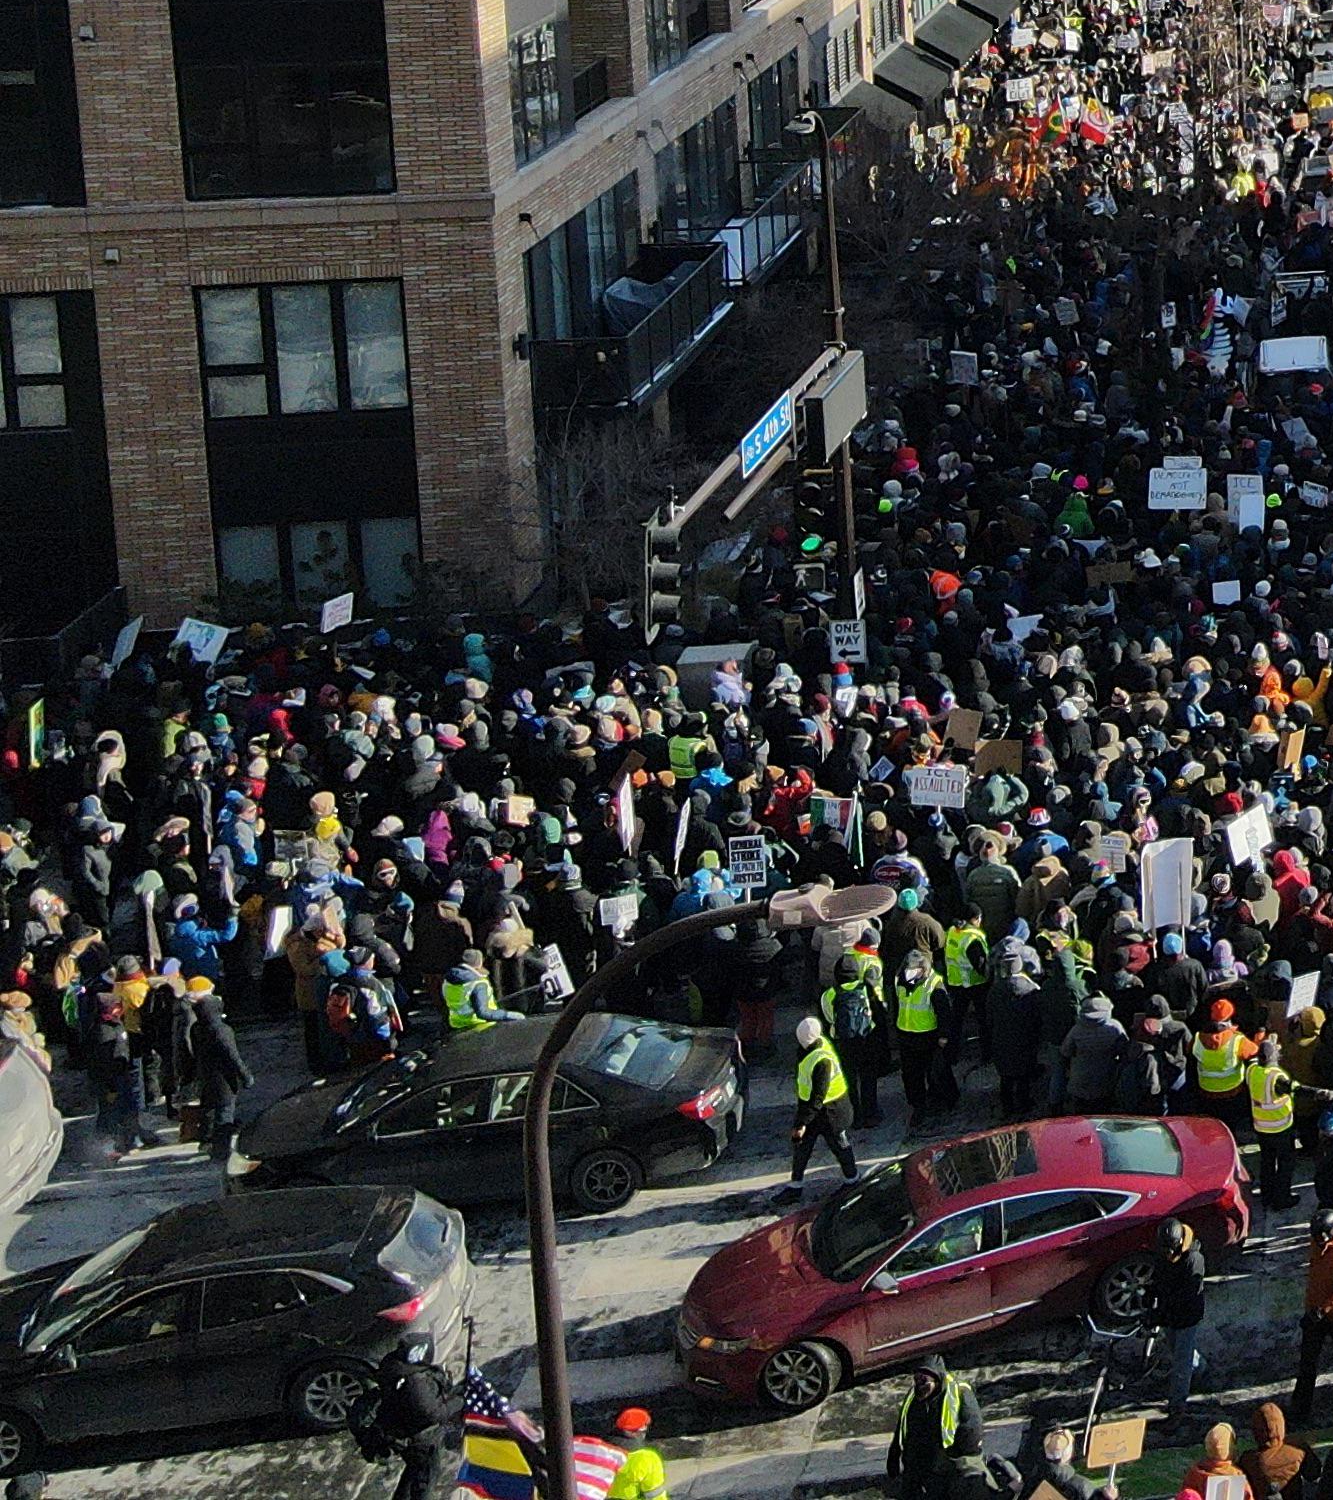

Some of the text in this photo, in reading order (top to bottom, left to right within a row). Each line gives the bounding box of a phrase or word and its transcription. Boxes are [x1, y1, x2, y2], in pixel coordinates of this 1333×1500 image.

[754, 402, 791, 455] S 4th St
[1233, 477, 1256, 488] ICE
[834, 623, 861, 634] ONE
[834, 634, 861, 646] WAY
[914, 777, 963, 794] ASSAULTED
[731, 850, 761, 862] STRIKE
[733, 873, 763, 884] JUSTICE
